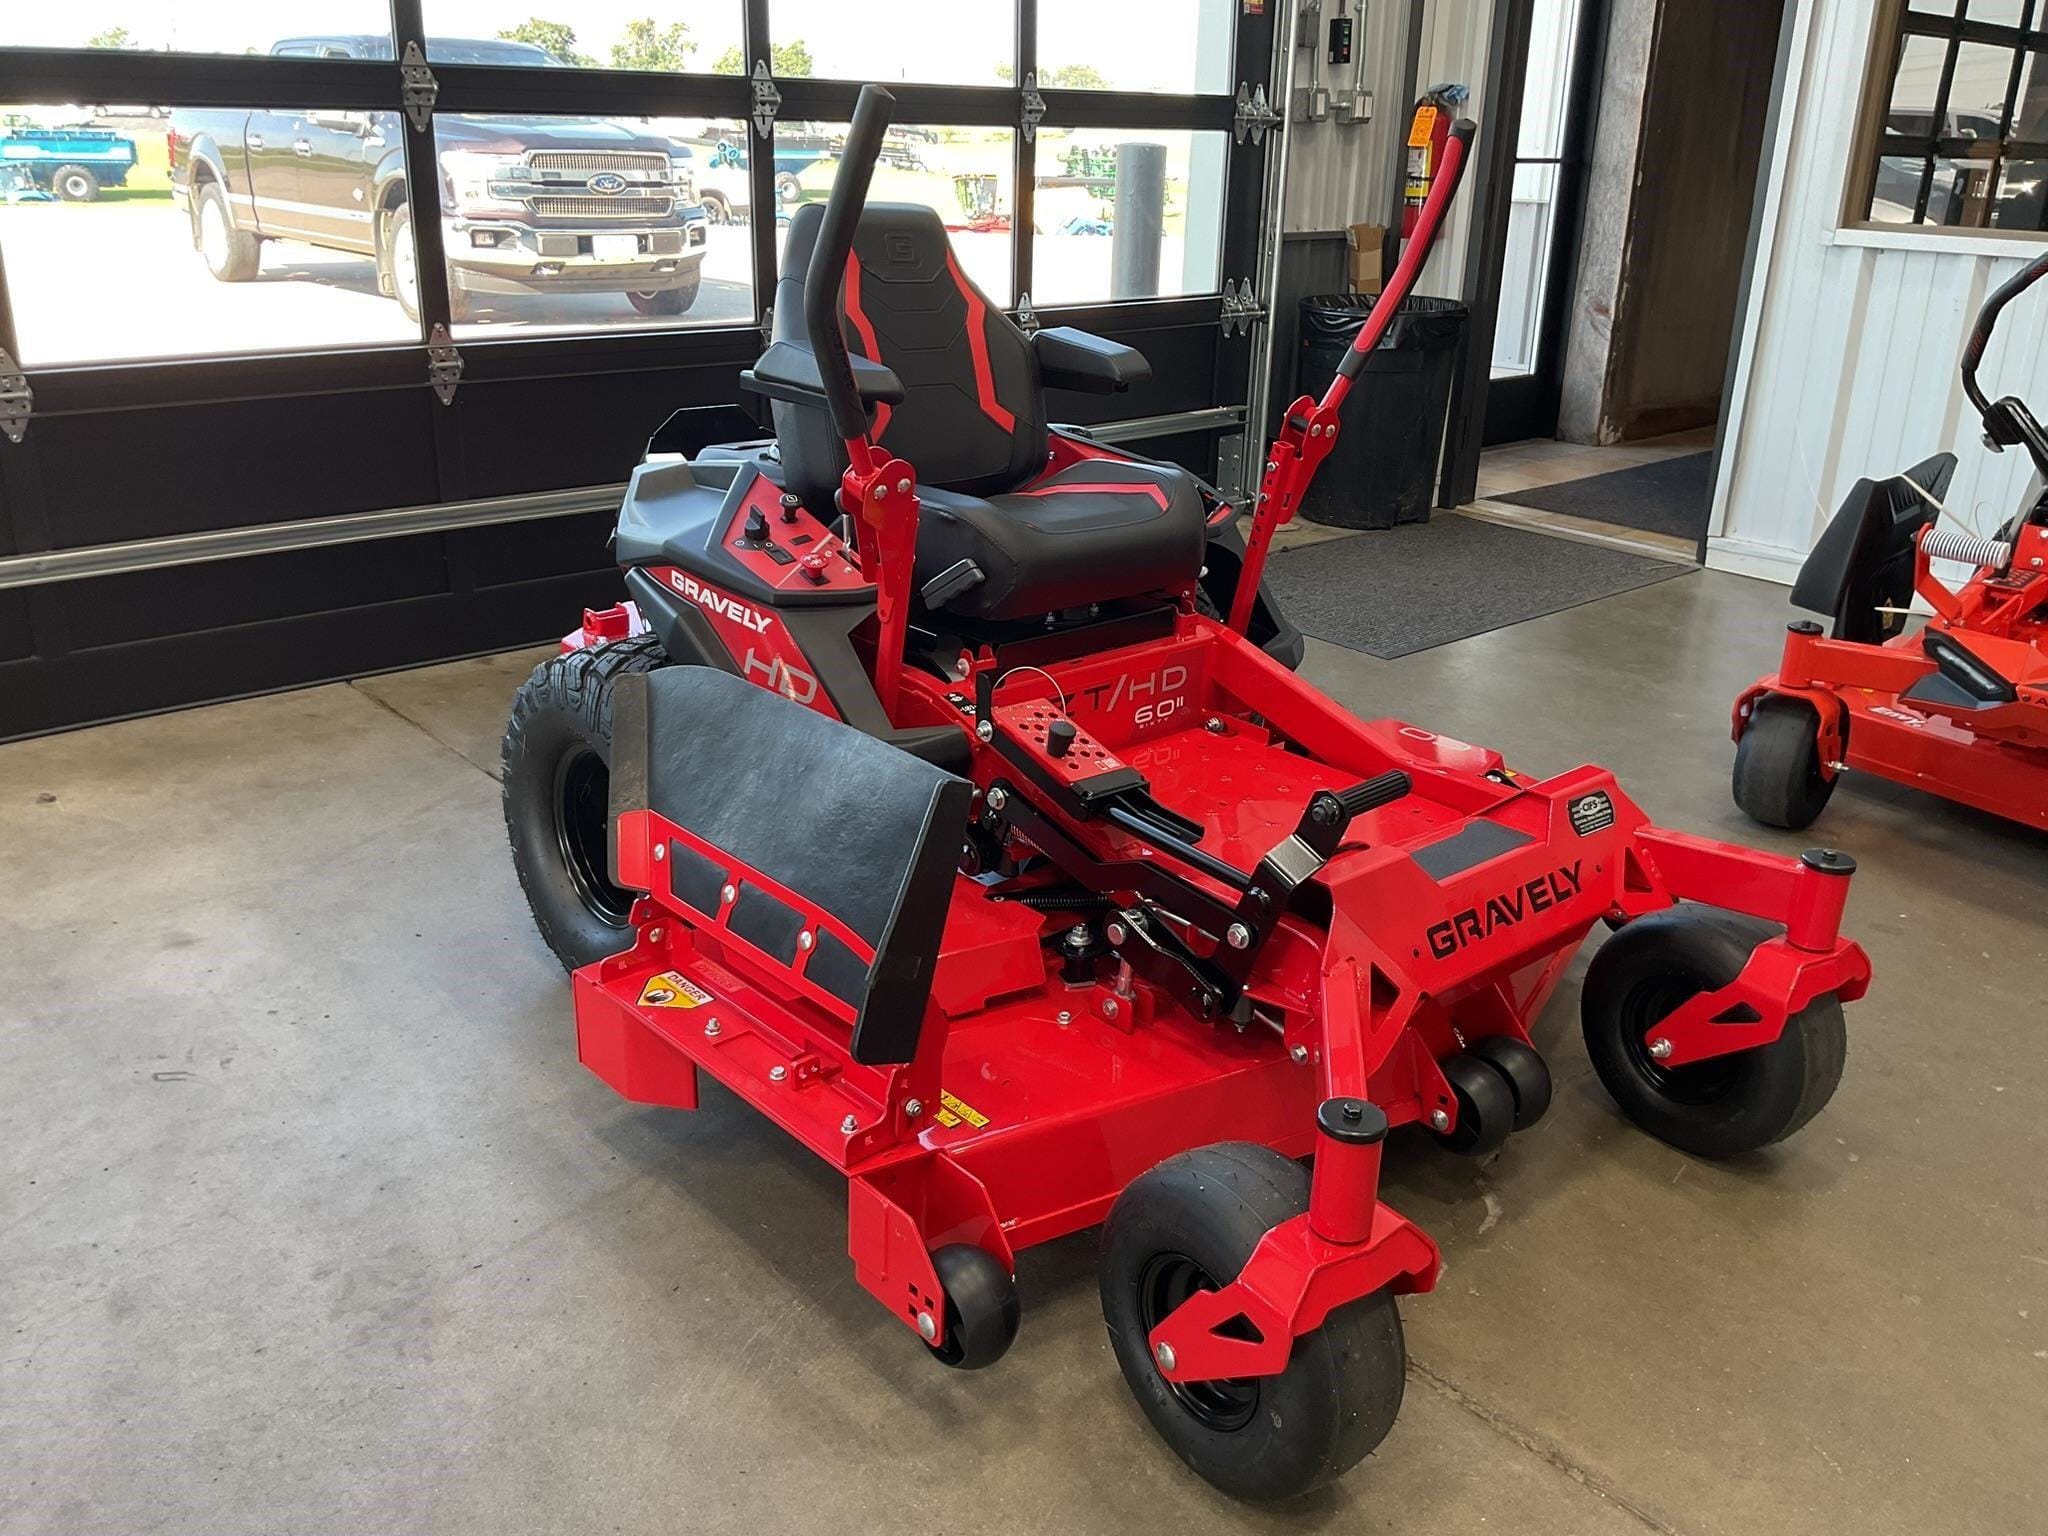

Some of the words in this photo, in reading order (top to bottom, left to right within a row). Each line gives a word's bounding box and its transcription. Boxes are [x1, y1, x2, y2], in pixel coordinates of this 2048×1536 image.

[671, 570, 772, 634] GRAVELY
[743, 647, 818, 704] HD
[1426, 858, 1583, 960] GRAVELY
[667, 973, 707, 1001] DANGER
